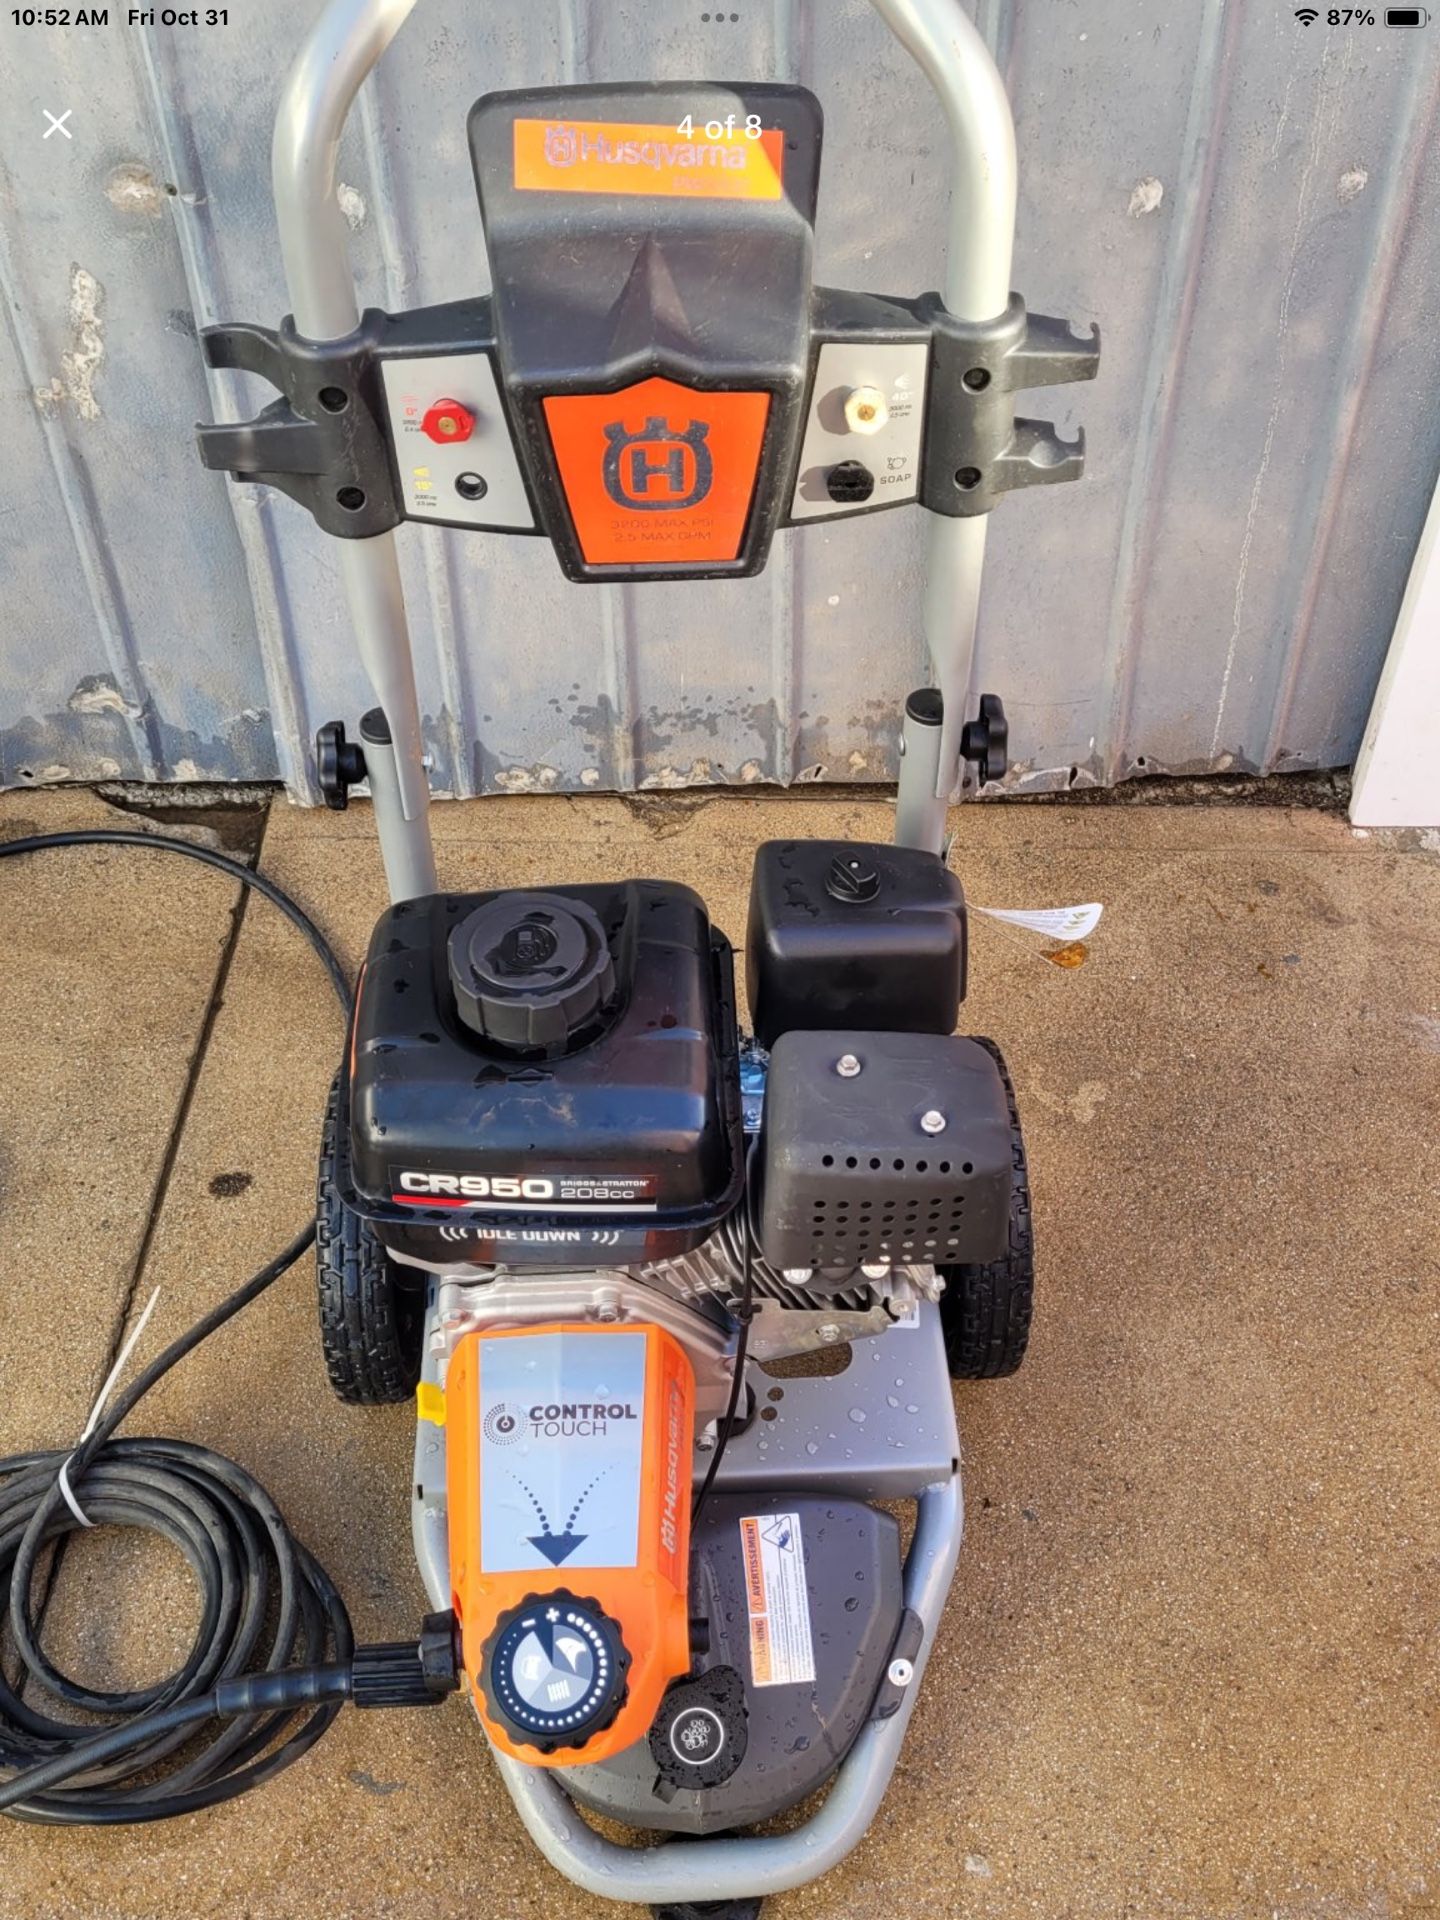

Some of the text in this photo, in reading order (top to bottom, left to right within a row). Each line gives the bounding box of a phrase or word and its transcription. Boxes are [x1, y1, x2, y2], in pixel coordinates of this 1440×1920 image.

[580, 133, 747, 170] Husqvarna
[880, 473, 912, 485] SOAP
[640, 531, 675, 542] MAX
[399, 1171, 554, 1199] CR950
[560, 1188, 635, 1200] 208cc
[529, 1403, 638, 1421] CONTROL
[530, 1421, 608, 1438] TOUCH
[746, 1522, 761, 1598] AVERTISSEMENT
